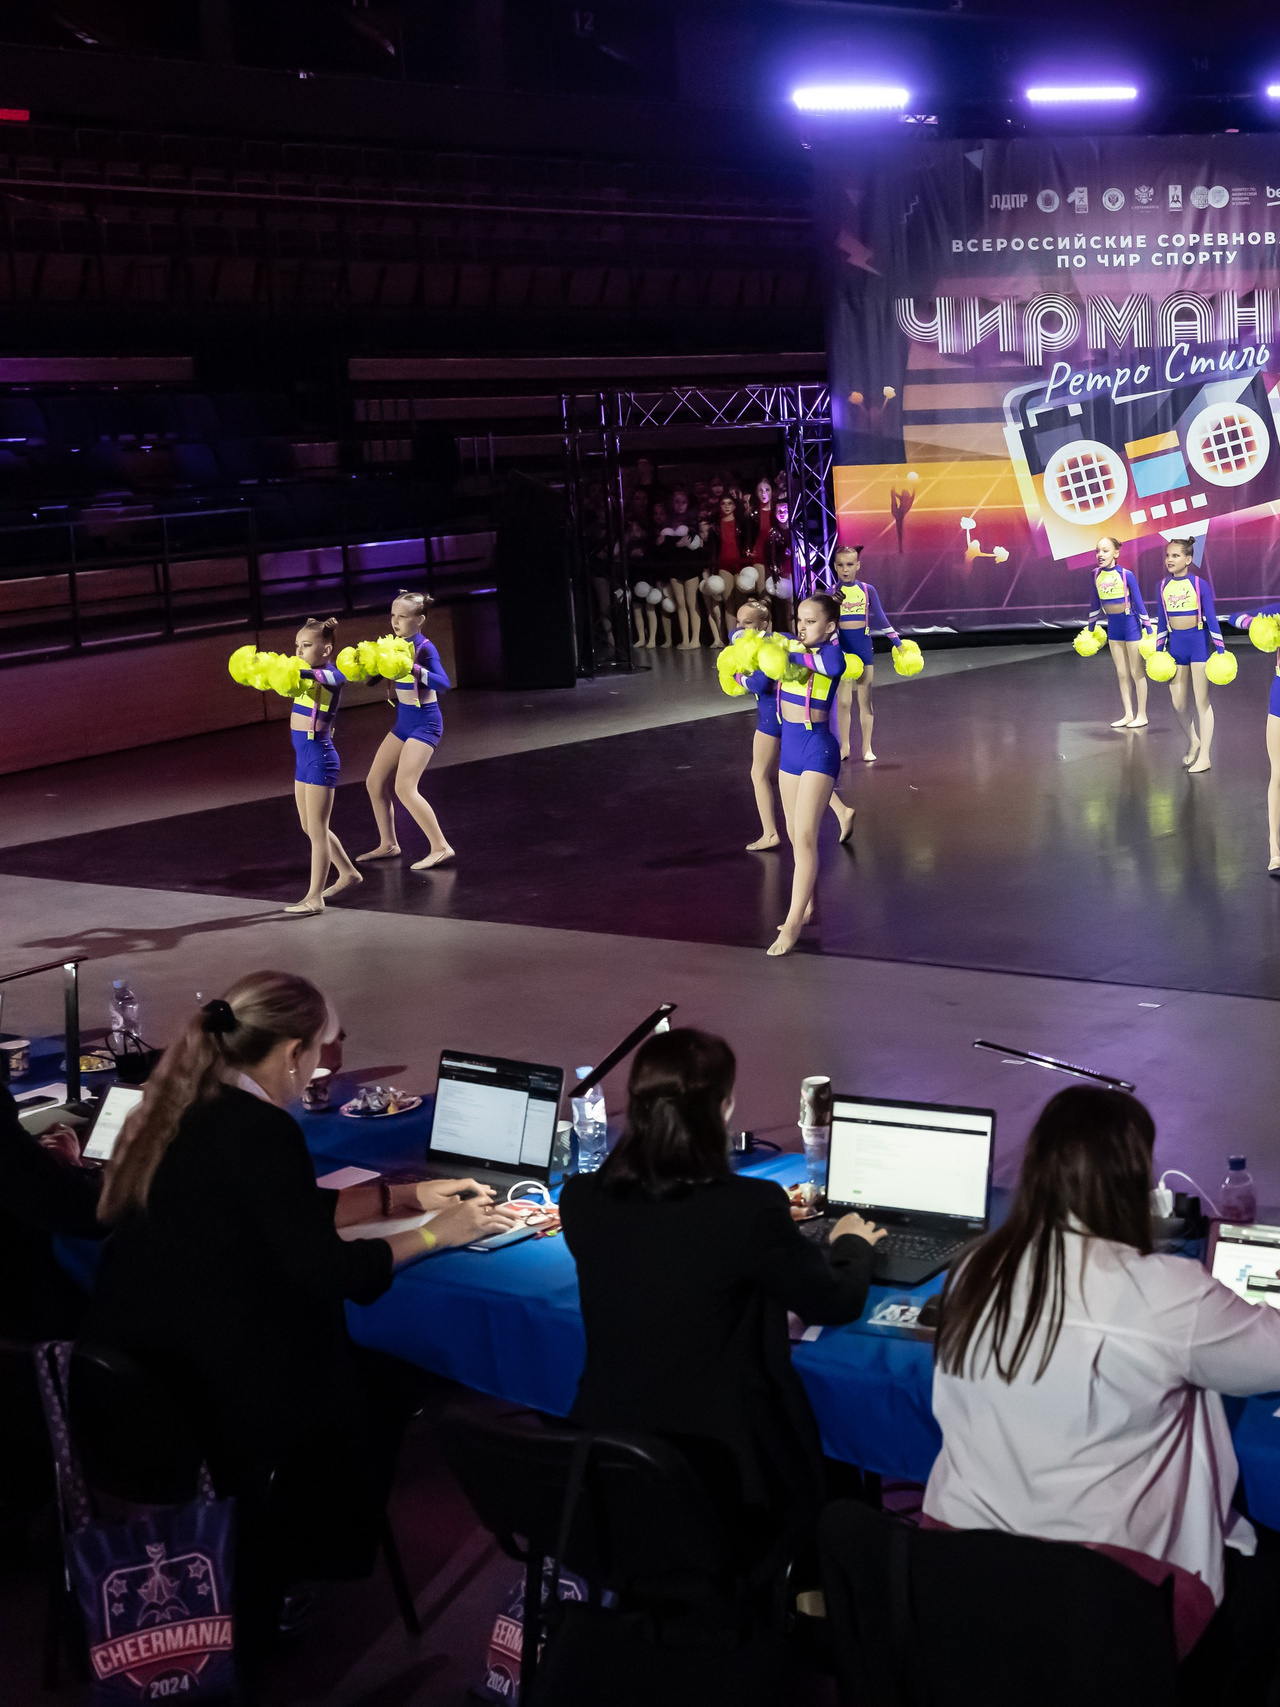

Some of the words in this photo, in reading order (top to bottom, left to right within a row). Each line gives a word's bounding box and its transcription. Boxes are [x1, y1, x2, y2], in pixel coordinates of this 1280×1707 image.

[990, 193, 1029, 211] ЛДПР
[951, 232, 1148, 253] ВСЕРОССИЙСКИЕ
[1056, 254, 1087, 269] ПО
[1097, 252, 1142, 268] ЧИР
[1151, 250, 1239, 266] СПОРТУ
[1044, 361, 1151, 403] Ретро
[1164, 341, 1271, 383] Стиль
[94, 1620, 233, 1673] CHEERMANIA
[150, 1674, 190, 1699] 2024
[486, 1670, 511, 1696] 2024
